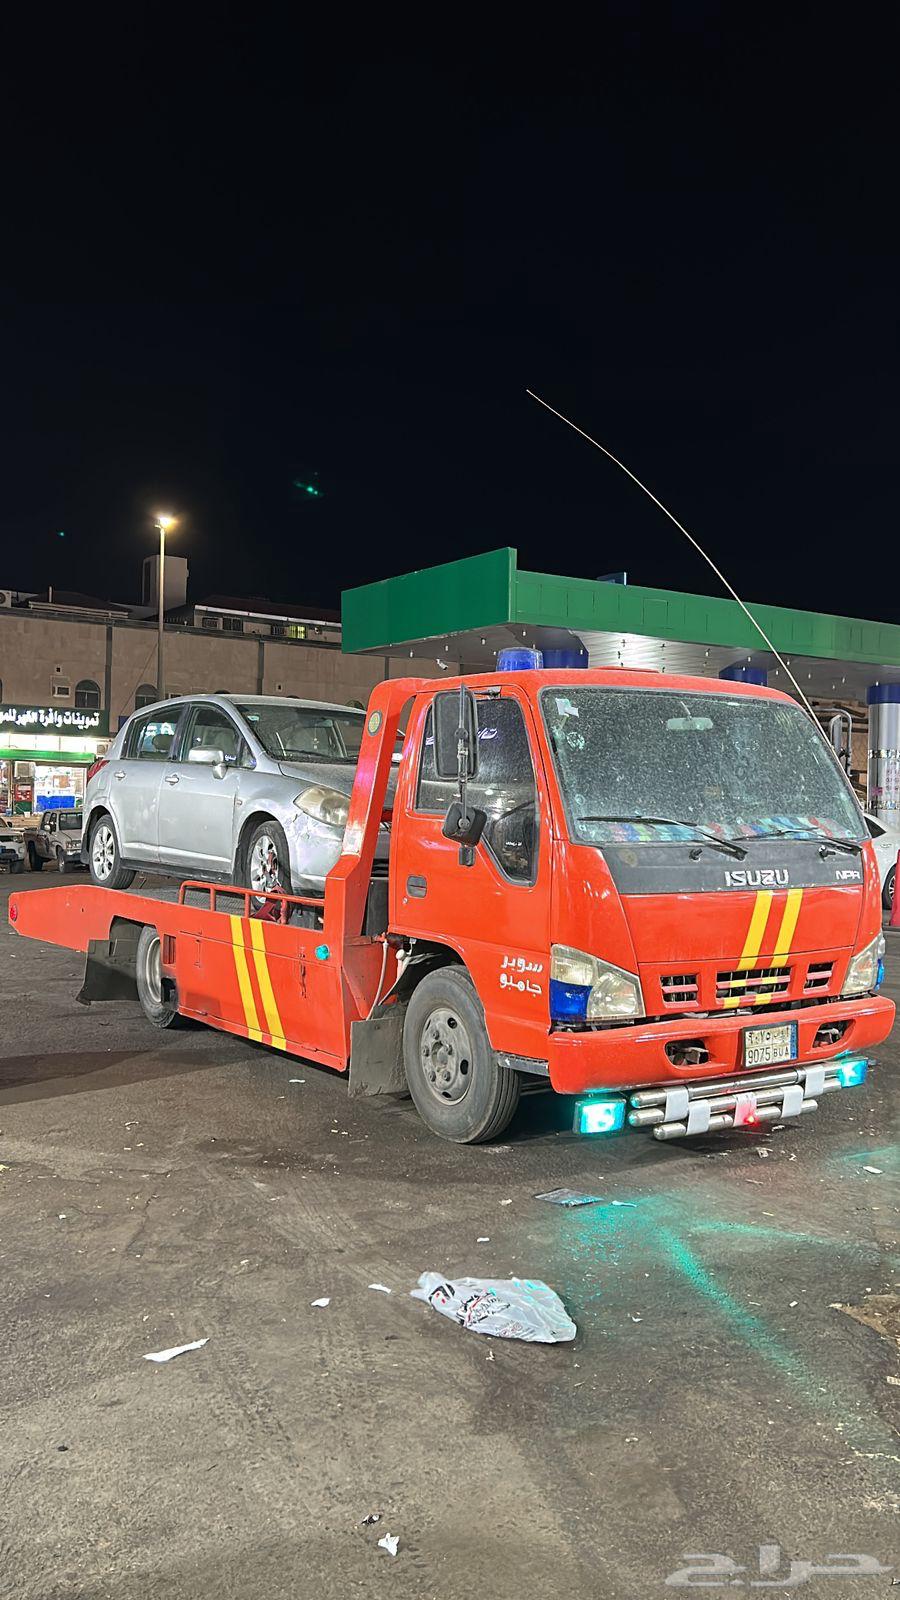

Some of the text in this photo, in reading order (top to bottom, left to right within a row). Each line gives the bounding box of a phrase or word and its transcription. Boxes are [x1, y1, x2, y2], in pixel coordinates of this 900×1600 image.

[63, 711, 100, 730] تموينات
[724, 869, 789, 887] ISUZU
[500, 955, 543, 973] سوبر
[500, 973, 543, 998] جامبو
[748, 1047, 771, 1064] 9075
